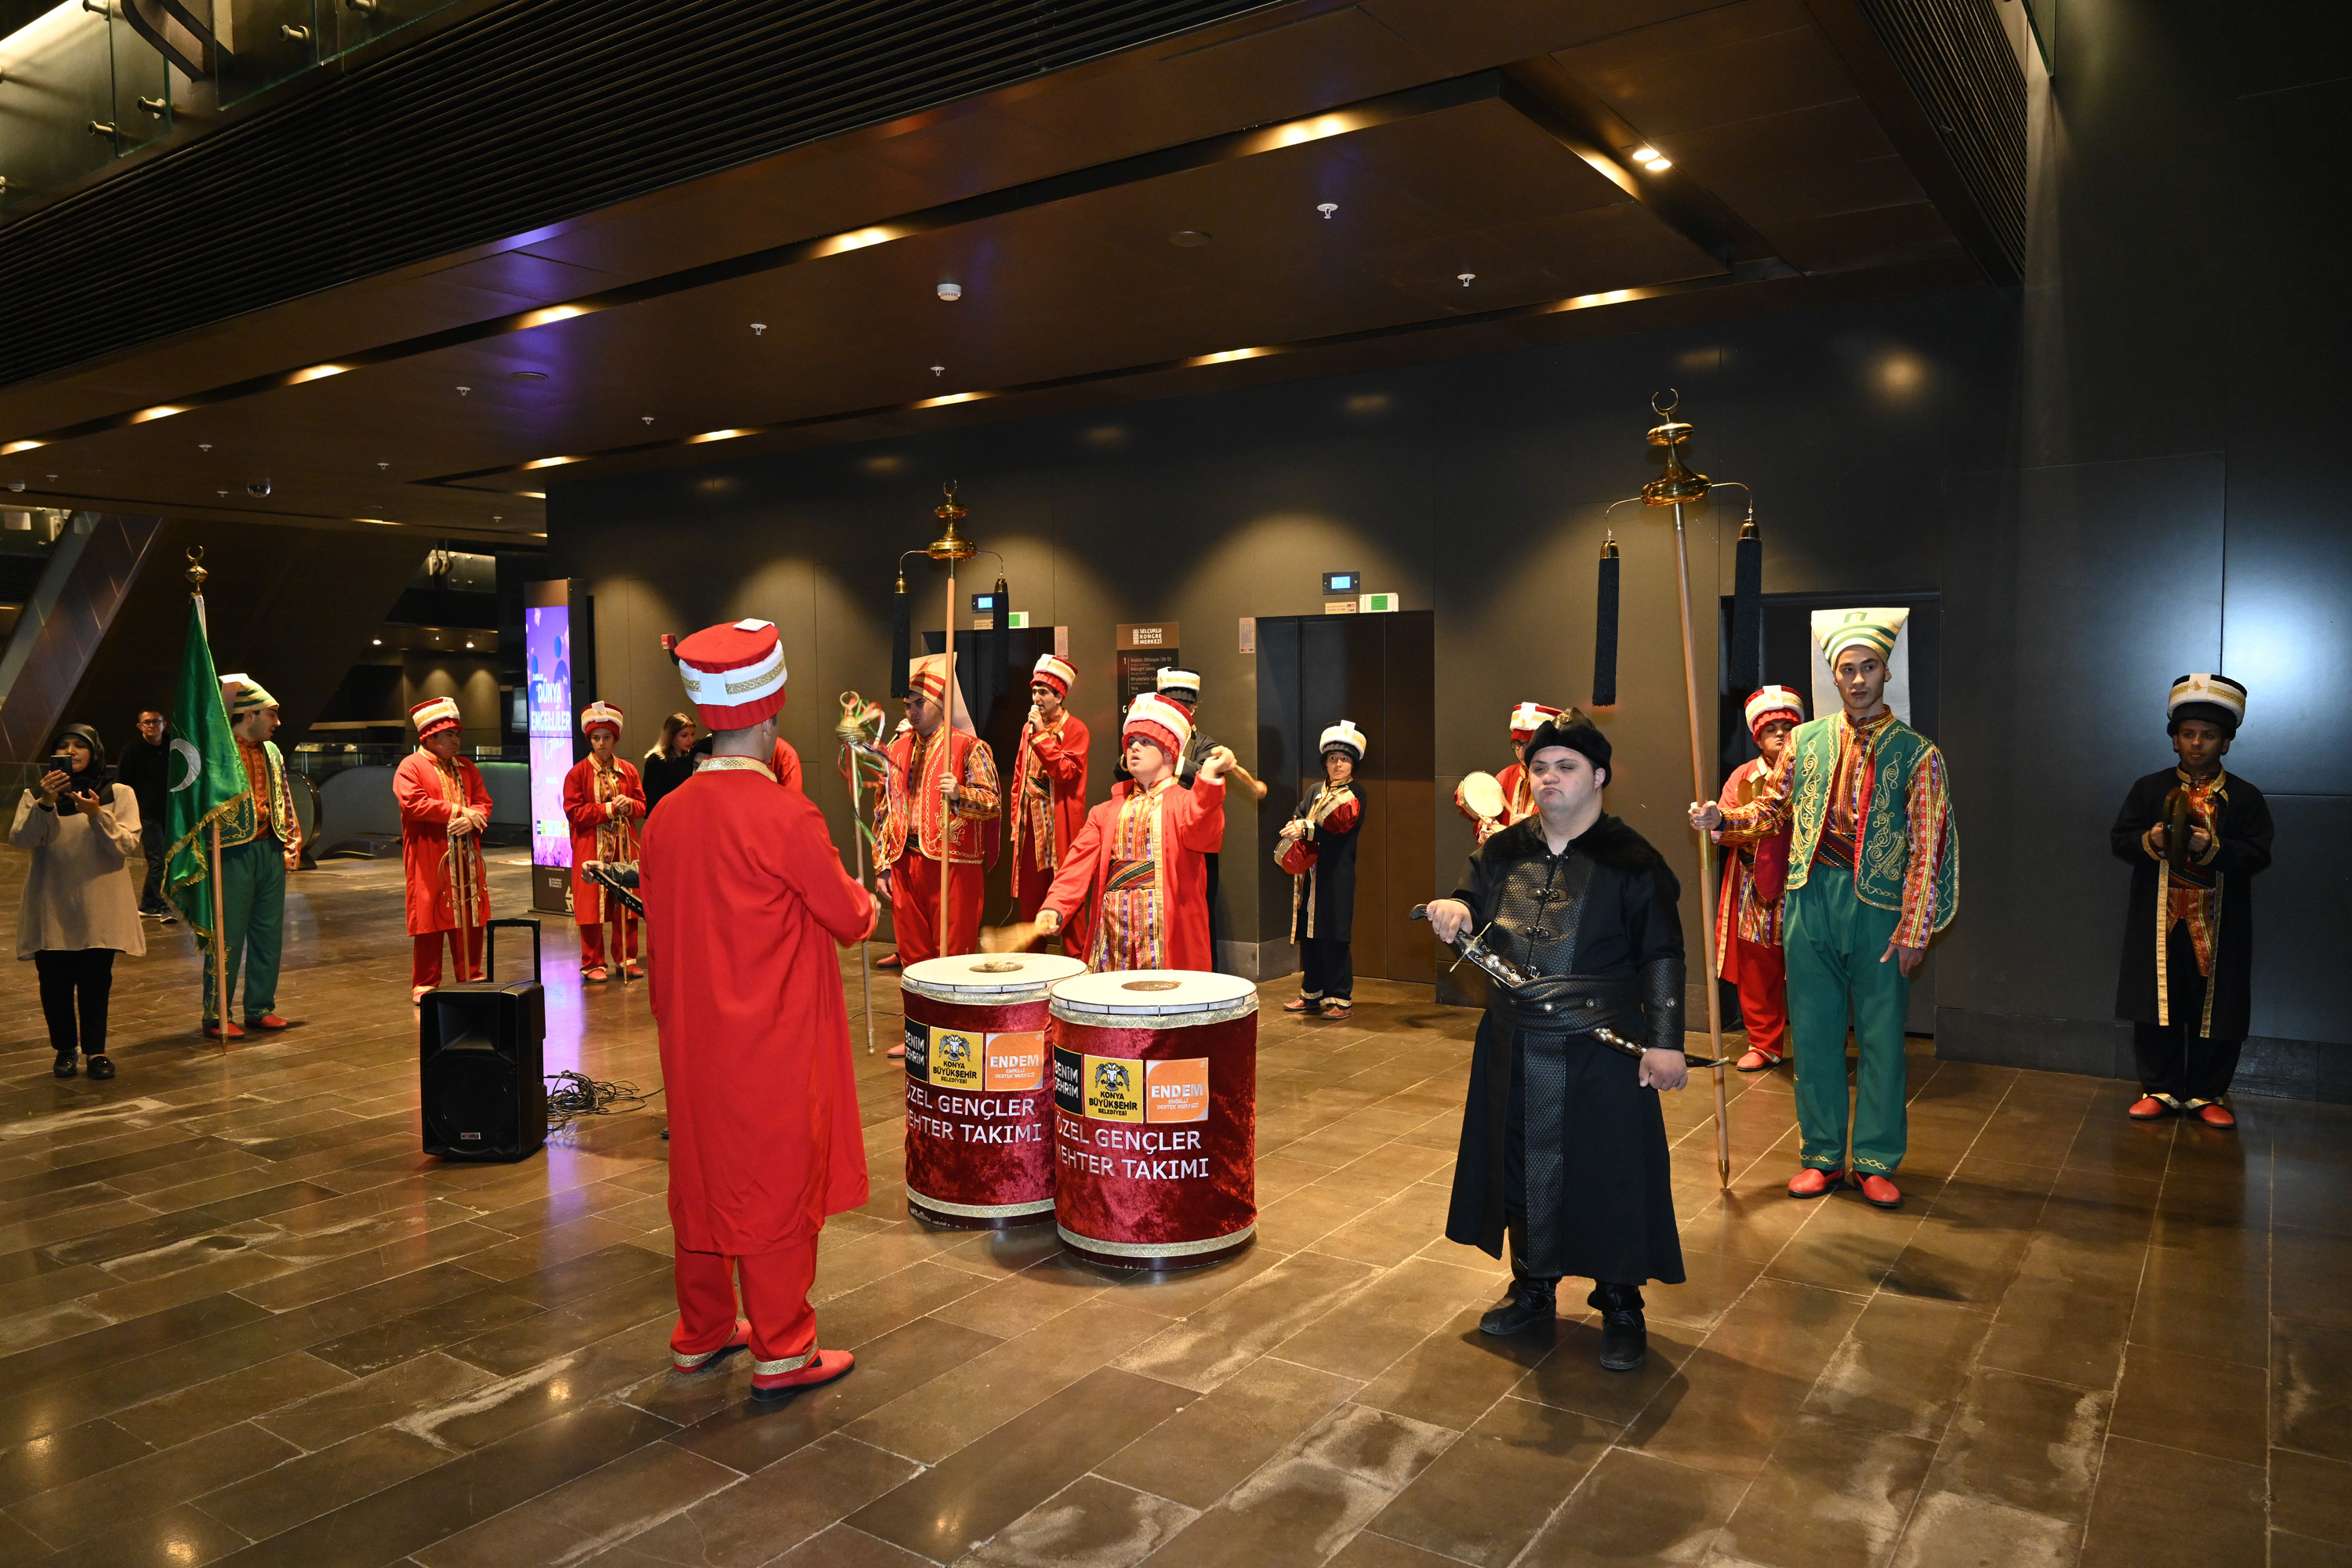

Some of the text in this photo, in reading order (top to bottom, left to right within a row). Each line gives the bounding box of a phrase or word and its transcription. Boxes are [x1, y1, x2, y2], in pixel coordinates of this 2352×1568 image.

[538, 677, 562, 703] DÜNYA
[1123, 705, 1127, 713] G
[531, 706, 571, 731] ENGELLİLER
[943, 1060, 965, 1069] KONYA
[990, 1054, 1039, 1068] ENDEM
[933, 1066, 977, 1079] BÜYÜKŞEHİR
[1101, 1091, 1124, 1100] KONYA
[1151, 1083, 1203, 1098] ENDEM
[906, 1077, 1035, 1120] ÖZEL GENÇLER
[1089, 1098, 1138, 1110] BÜYÜKŞEHİR
[907, 1108, 1042, 1144] EHTER TAKIMI
[1057, 1110, 1201, 1155] ÖZEL GENÇLER
[1121, 1158, 1209, 1180] TAKIMI
